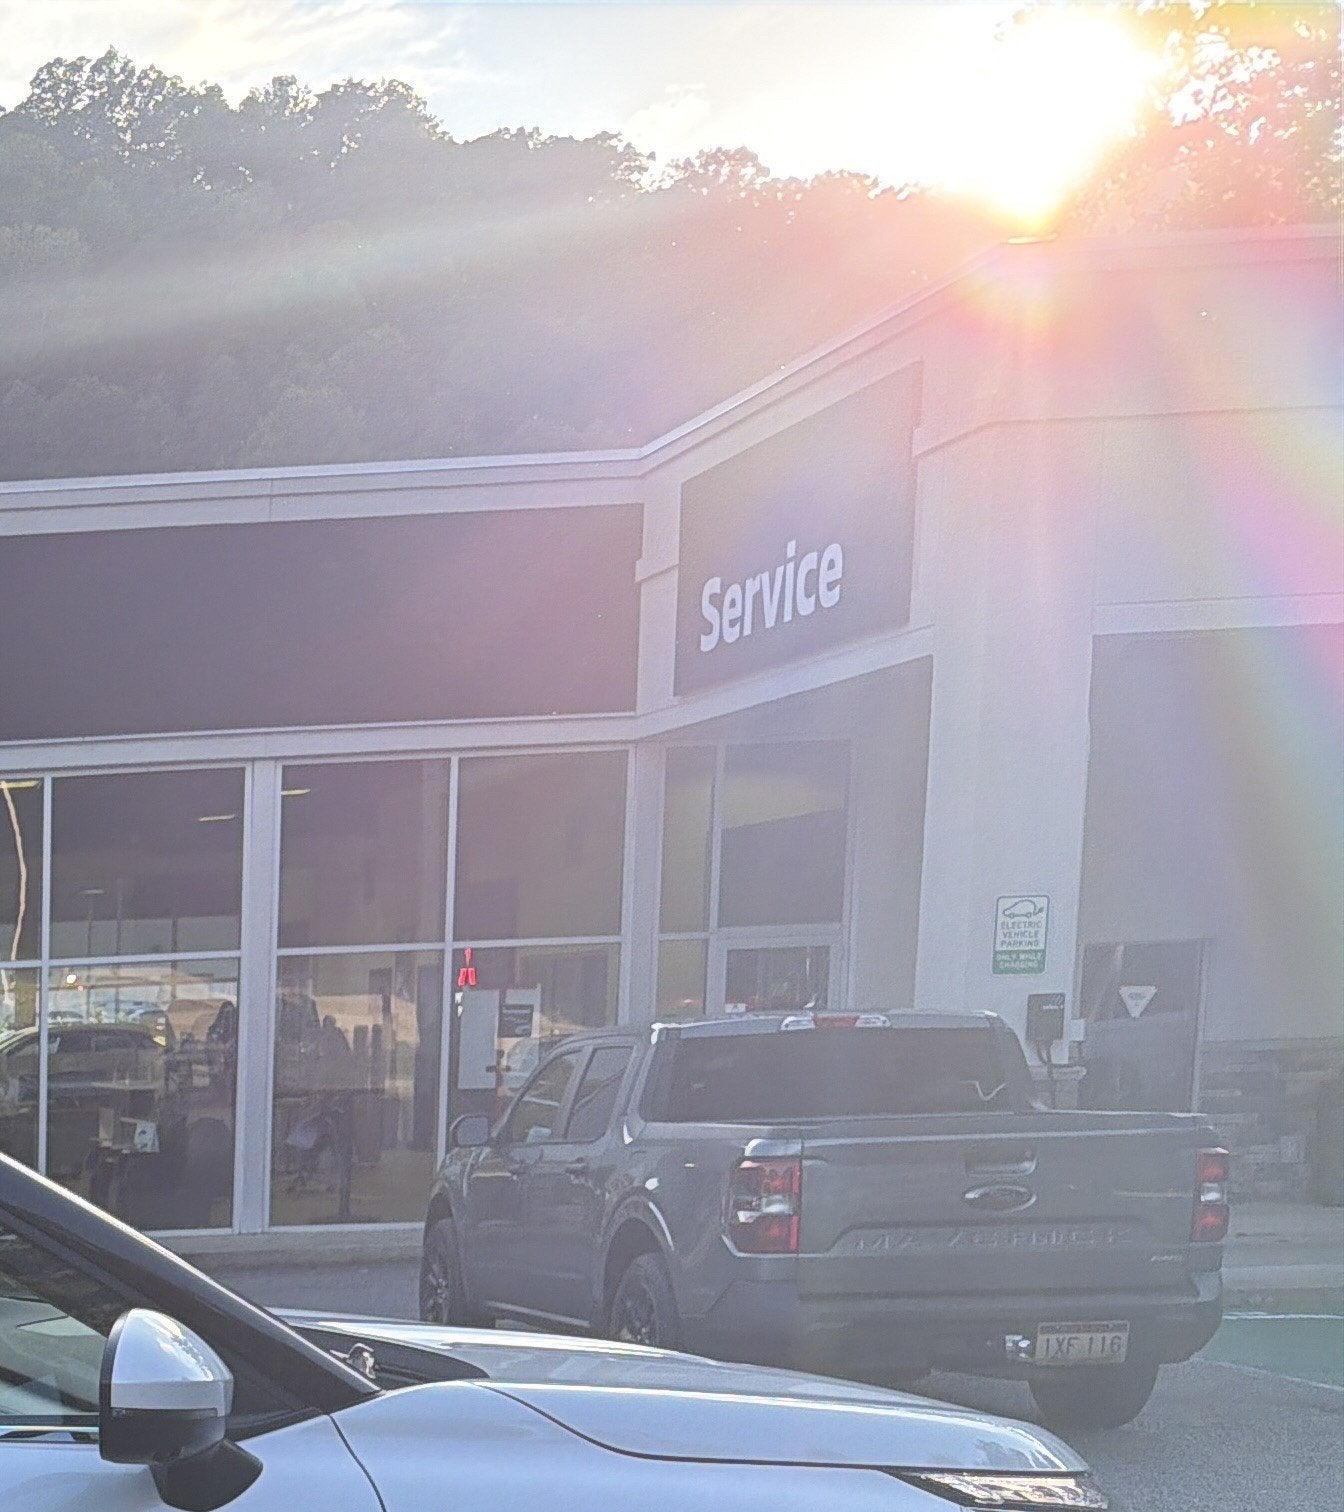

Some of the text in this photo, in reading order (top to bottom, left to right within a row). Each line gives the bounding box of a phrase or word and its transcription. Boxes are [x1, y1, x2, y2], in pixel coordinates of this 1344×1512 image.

[700, 539, 843, 652] Service
[1000, 920, 1042, 930] ELECTRIC
[1002, 930, 1039, 938] VEHICLE
[1000, 939, 1039, 947] PARKING
